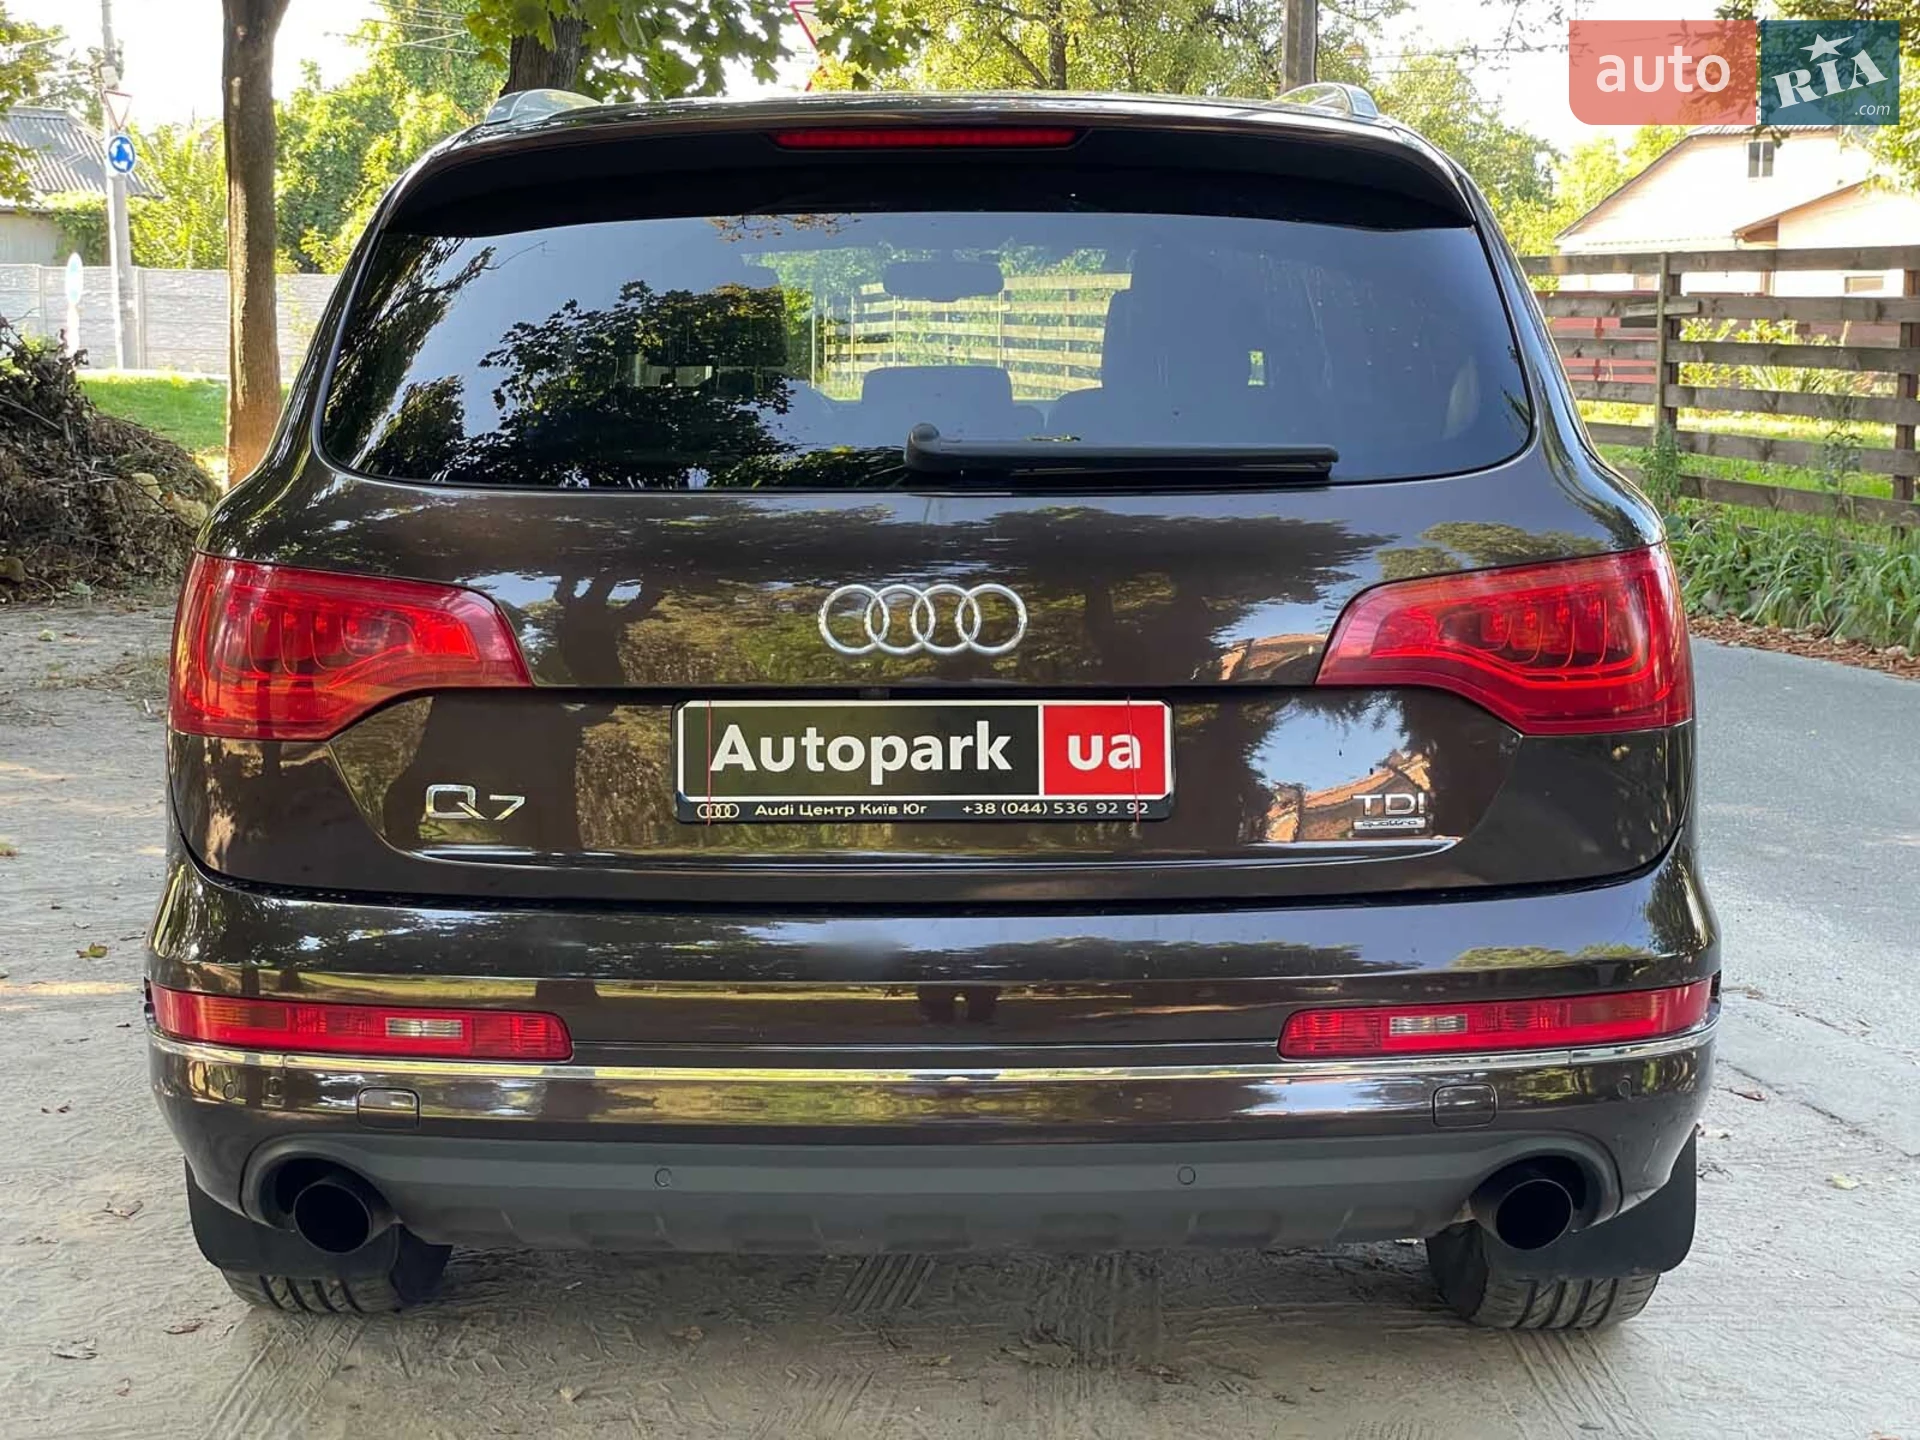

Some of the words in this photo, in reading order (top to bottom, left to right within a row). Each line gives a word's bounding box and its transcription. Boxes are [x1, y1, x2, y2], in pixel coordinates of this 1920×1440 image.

[710, 720, 1013, 785] Autopark
[1068, 733, 1142, 770] ua
[426, 784, 525, 820] Q7
[754, 804, 794, 816] Audi
[799, 805, 856, 817] Центр
[860, 803, 898, 815] Київ
[903, 803, 927, 815] Юг
[962, 802, 996, 814] +38
[1001, 801, 1048, 815] (044)
[1053, 802, 1088, 814] 536
[1096, 802, 1118, 814] 92
[1126, 802, 1149, 814] 92
[1353, 793, 1425, 815] TDI
[1362, 819, 1417, 828] quattro
